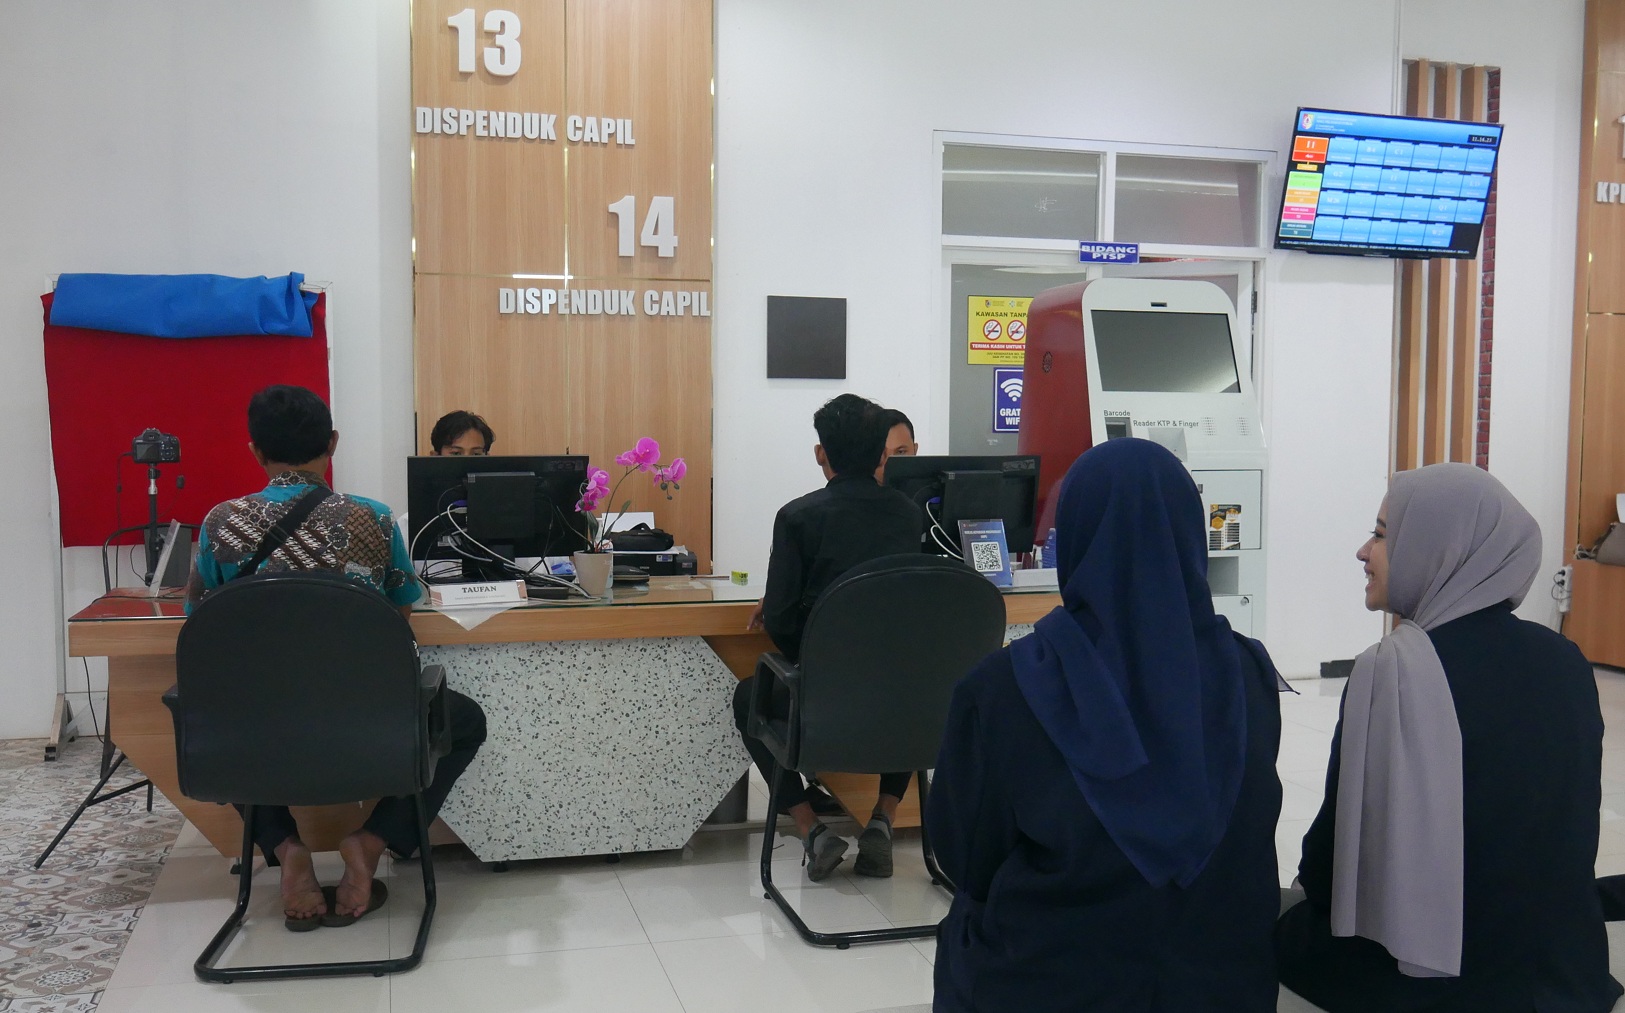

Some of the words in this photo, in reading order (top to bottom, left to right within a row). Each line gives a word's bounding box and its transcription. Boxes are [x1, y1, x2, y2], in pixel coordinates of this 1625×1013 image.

[447, 8, 522, 77] 13
[415, 106, 557, 141] DISPENDUK
[566, 115, 636, 145] CAPIL
[607, 195, 678, 258] 14
[1081, 245, 1136, 254] BIDANG
[1092, 252, 1126, 260] PTSP
[500, 288, 636, 316] DISPENDUK
[643, 290, 711, 317] CAPIL
[1000, 408, 1021, 417] GRAT
[1005, 417, 1020, 425] WIF
[1179, 420, 1199, 428] Finger
[461, 585, 497, 594] TAUFAN
